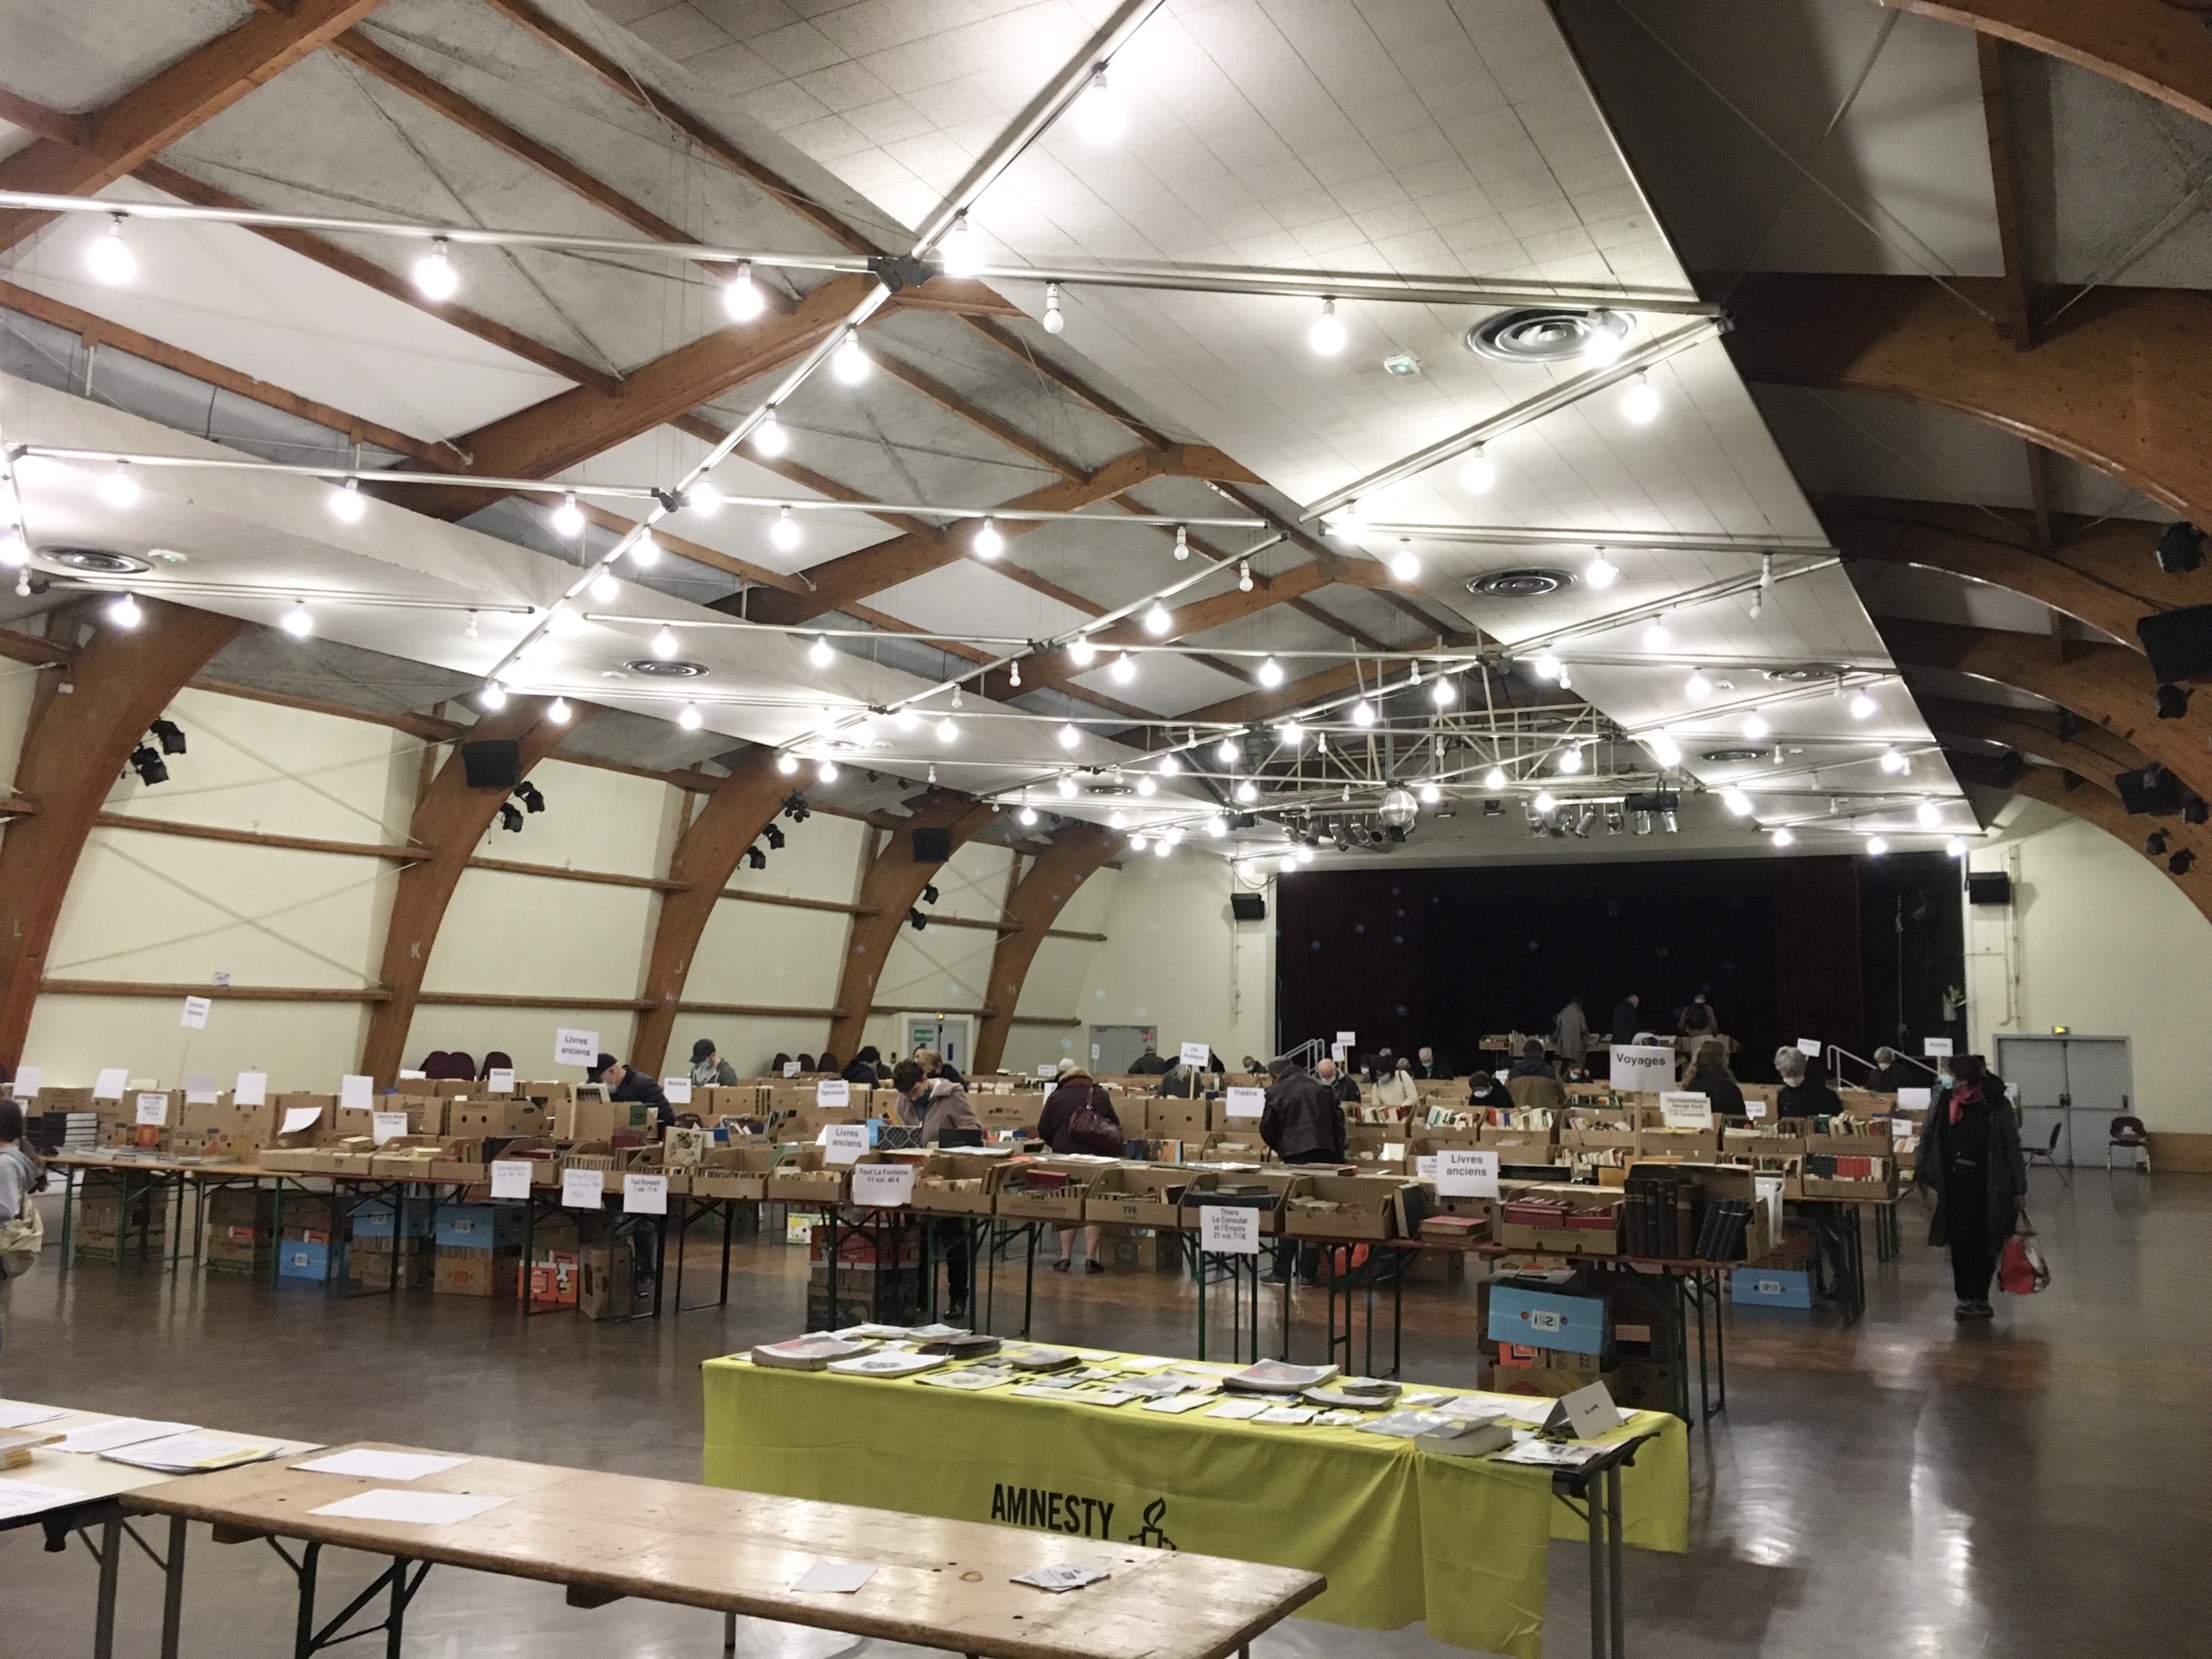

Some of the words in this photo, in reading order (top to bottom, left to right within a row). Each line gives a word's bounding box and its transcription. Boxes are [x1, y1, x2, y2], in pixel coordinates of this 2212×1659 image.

[410, 942, 421, 959] K
[674, 959, 683, 975] J
[1008, 984, 1016, 995] H
[564, 1035, 588, 1046] Livres
[561, 1046, 591, 1057] anciens
[1616, 1052, 1667, 1068] Voyages
[835, 1128, 859, 1138] Livres
[832, 1139, 862, 1148] anciens
[1451, 1154, 1484, 1164] Livres
[1446, 1166, 1488, 1177] anciens
[1221, 1216, 1248, 1224] Consulat
[1221, 1224, 1246, 1232] l'Empire
[990, 1483, 1115, 1540] AMNESTY
